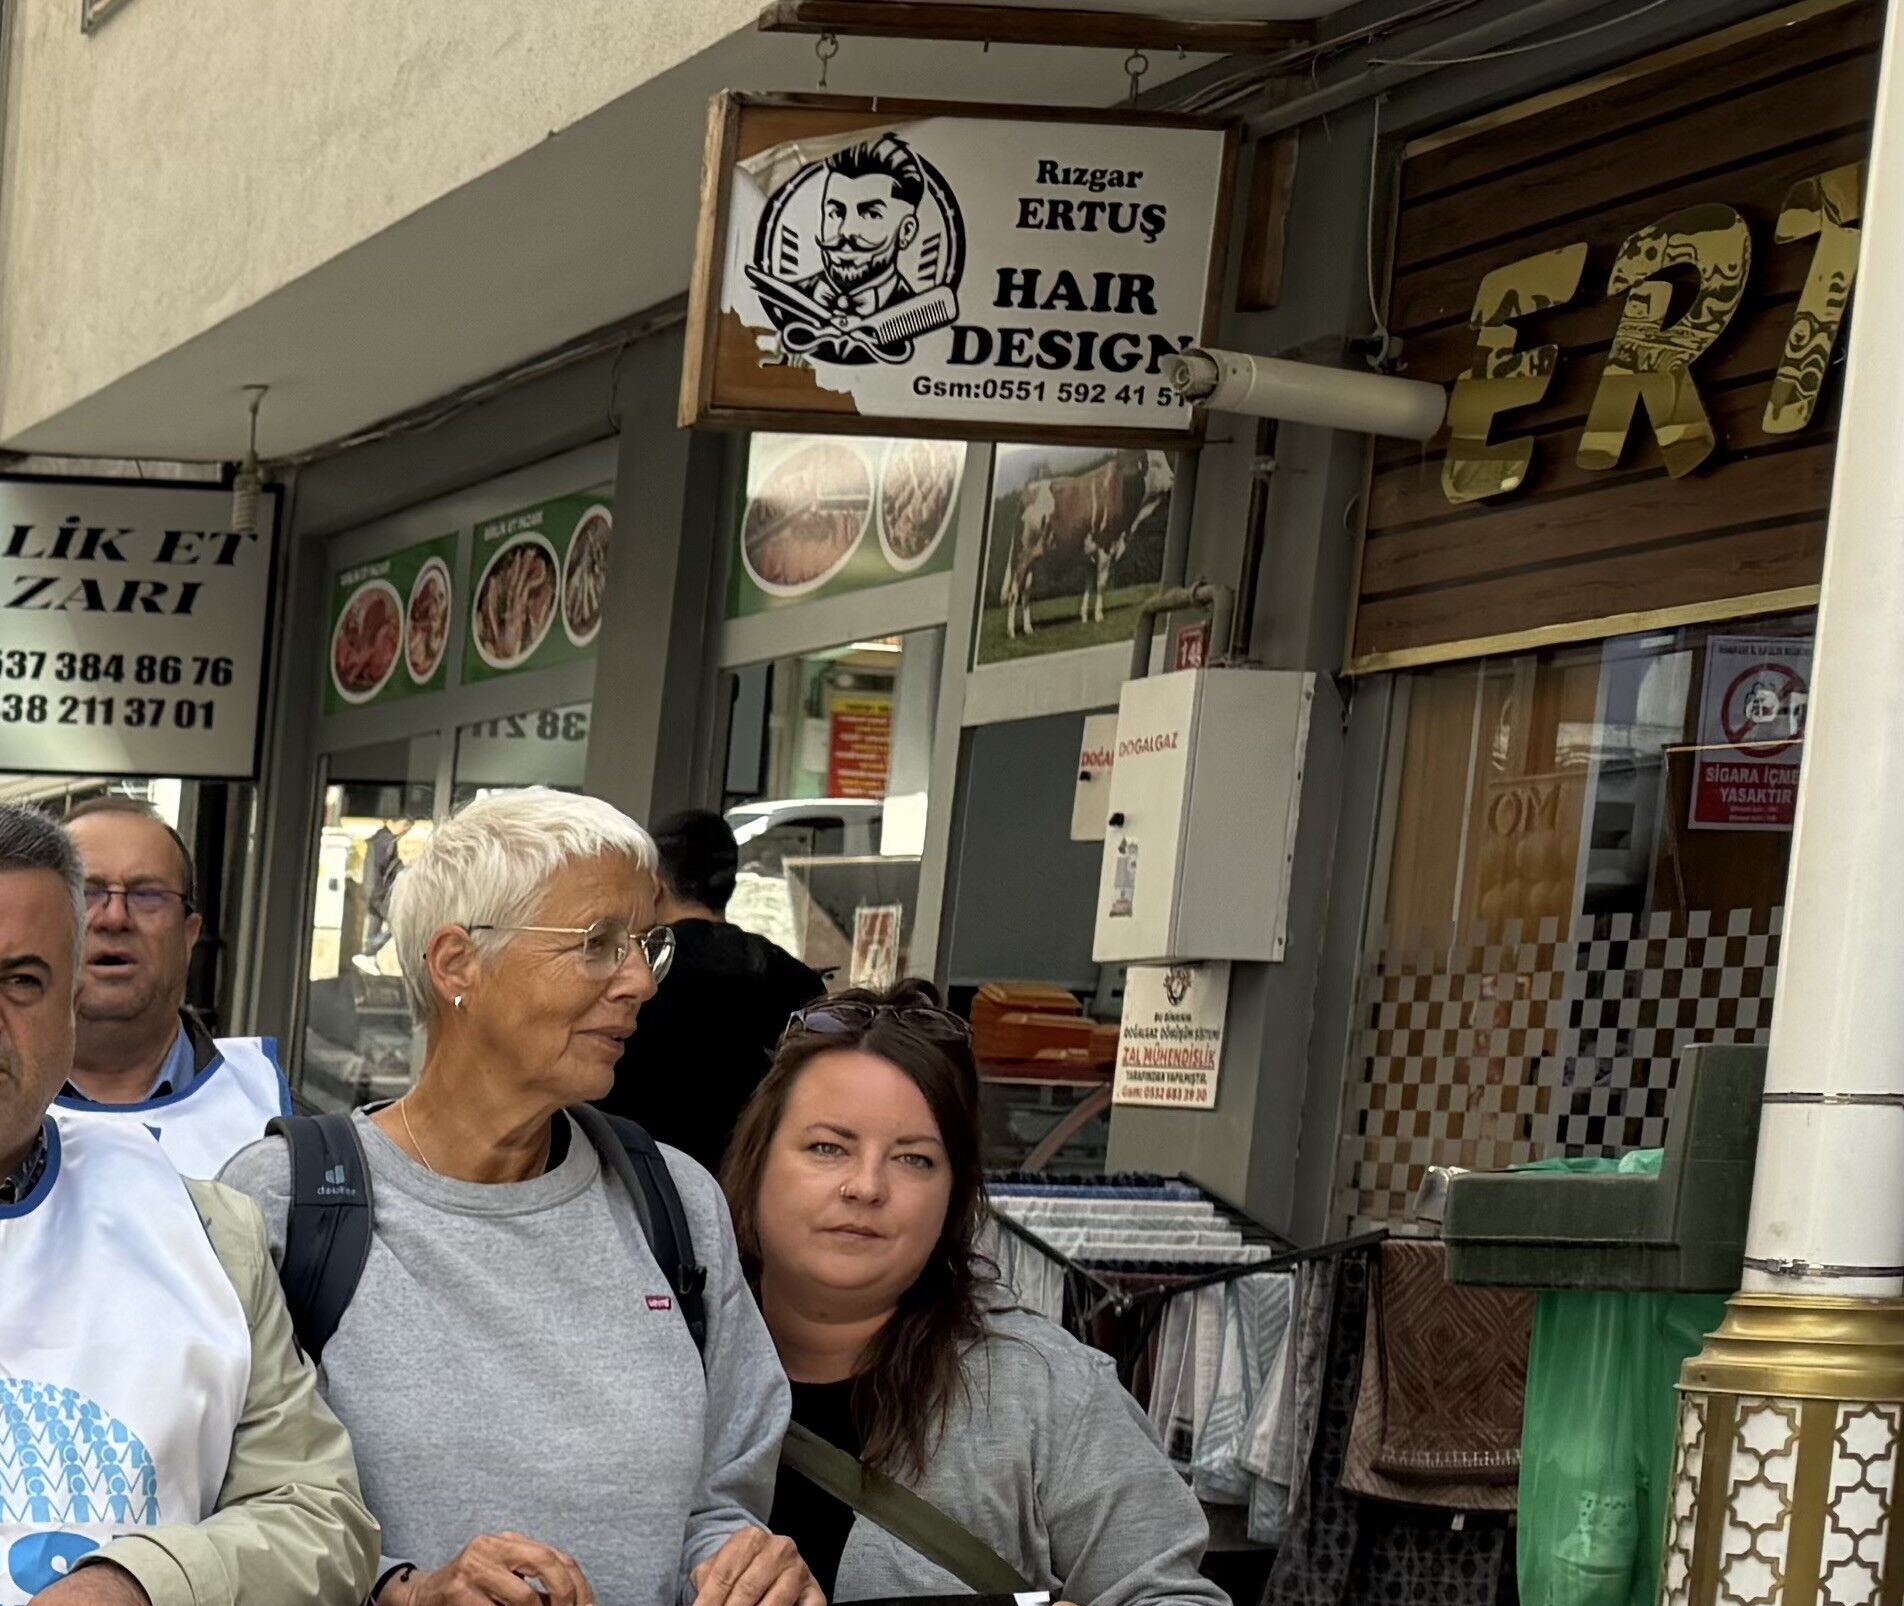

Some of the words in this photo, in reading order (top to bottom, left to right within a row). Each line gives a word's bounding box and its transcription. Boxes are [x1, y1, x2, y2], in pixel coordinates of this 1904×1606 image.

[1037, 159, 1144, 192] Rızgar
[1016, 197, 1166, 243] ERTUŞ
[992, 267, 1158, 315] HAIR
[946, 325, 1195, 374] DESIGN
[912, 375, 1046, 403] Gsm:0551
[1057, 381, 1106, 404] 592
[1115, 383, 1145, 406] 41
[153, 530, 258, 567] ET
[54, 651, 125, 684] 384
[134, 654, 186, 685] 86
[191, 656, 233, 686] 76
[59, 695, 114, 727] 211
[123, 698, 166, 729] 37
[173, 699, 216, 730] 01
[1706, 764, 1760, 784] SİGARA
[1720, 787, 1792, 805] YASAKTIR
